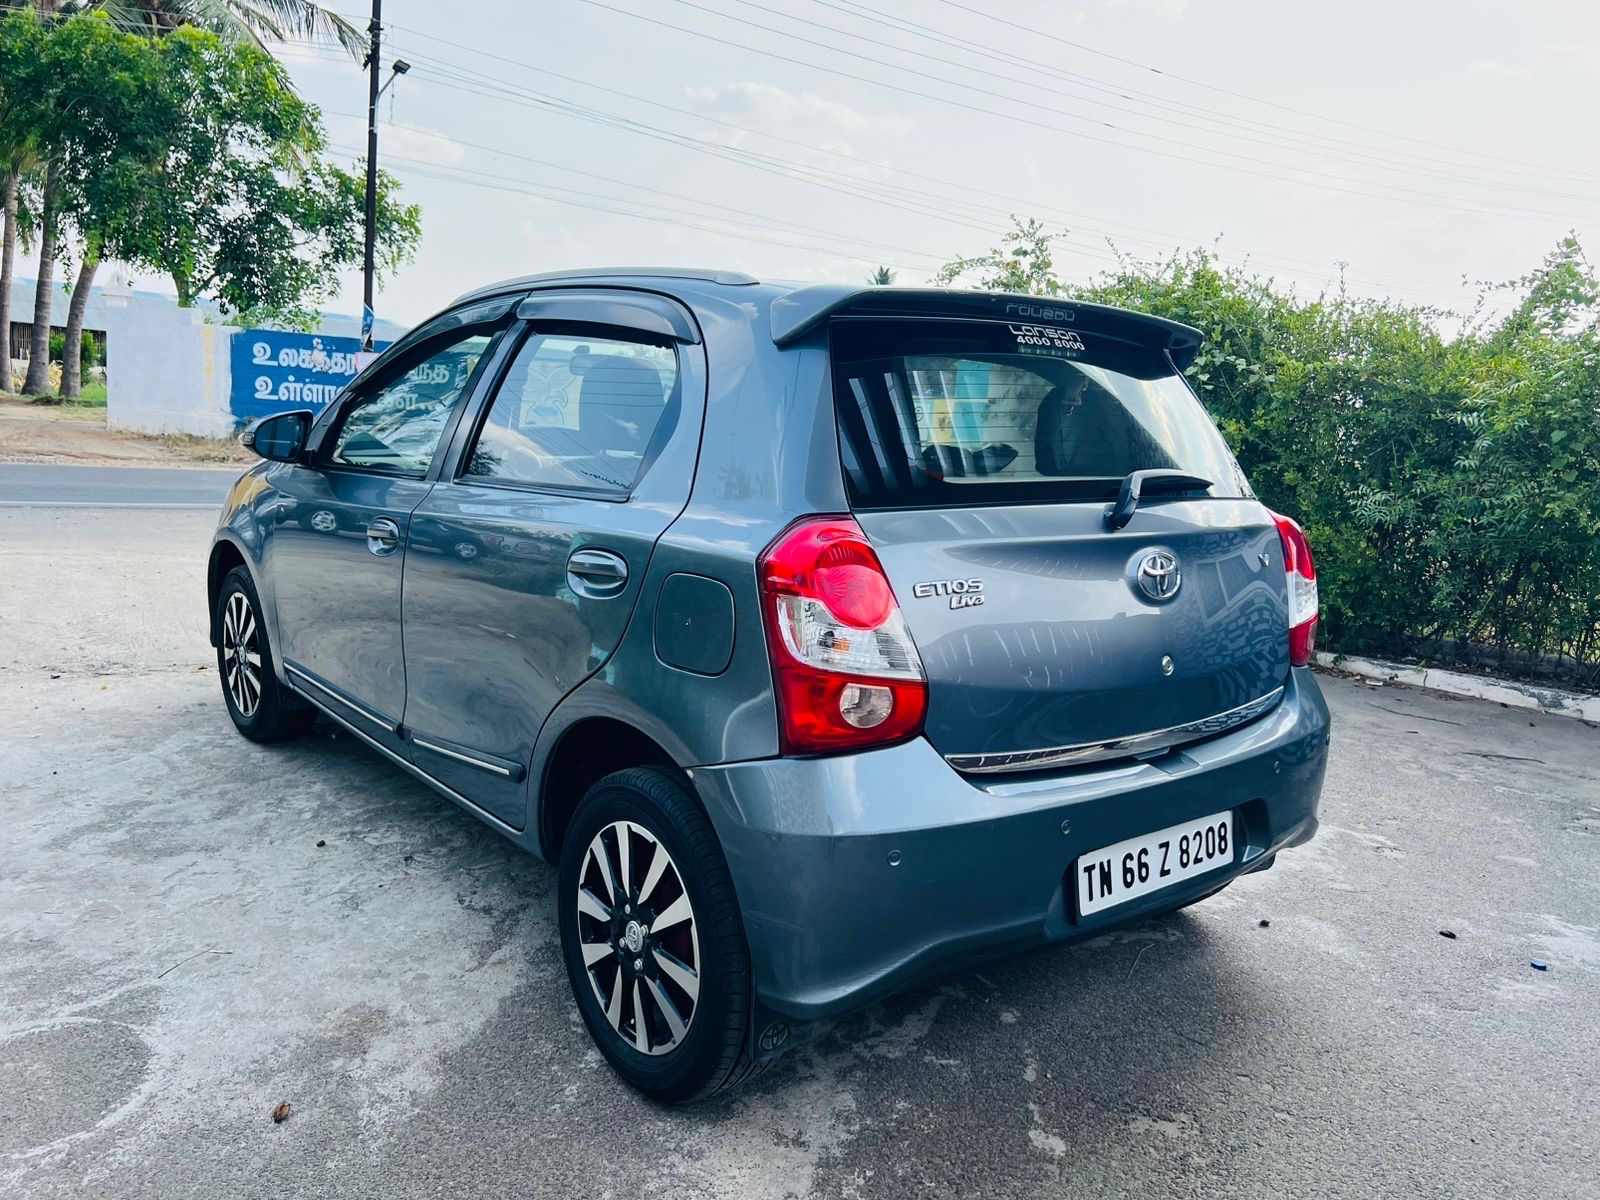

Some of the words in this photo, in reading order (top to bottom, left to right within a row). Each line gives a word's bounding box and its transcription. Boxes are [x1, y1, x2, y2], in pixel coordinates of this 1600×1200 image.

[1016, 335, 1051, 346] 4000
[254, 375, 346, 404] உள்ளா
[912, 577, 984, 598] ETIOS
[949, 594, 985, 610] Liva
[1083, 858, 1113, 902] TN
[1122, 847, 1150, 889] 66
[1158, 840, 1171, 878] Z
[1179, 821, 1228, 870] 8208
